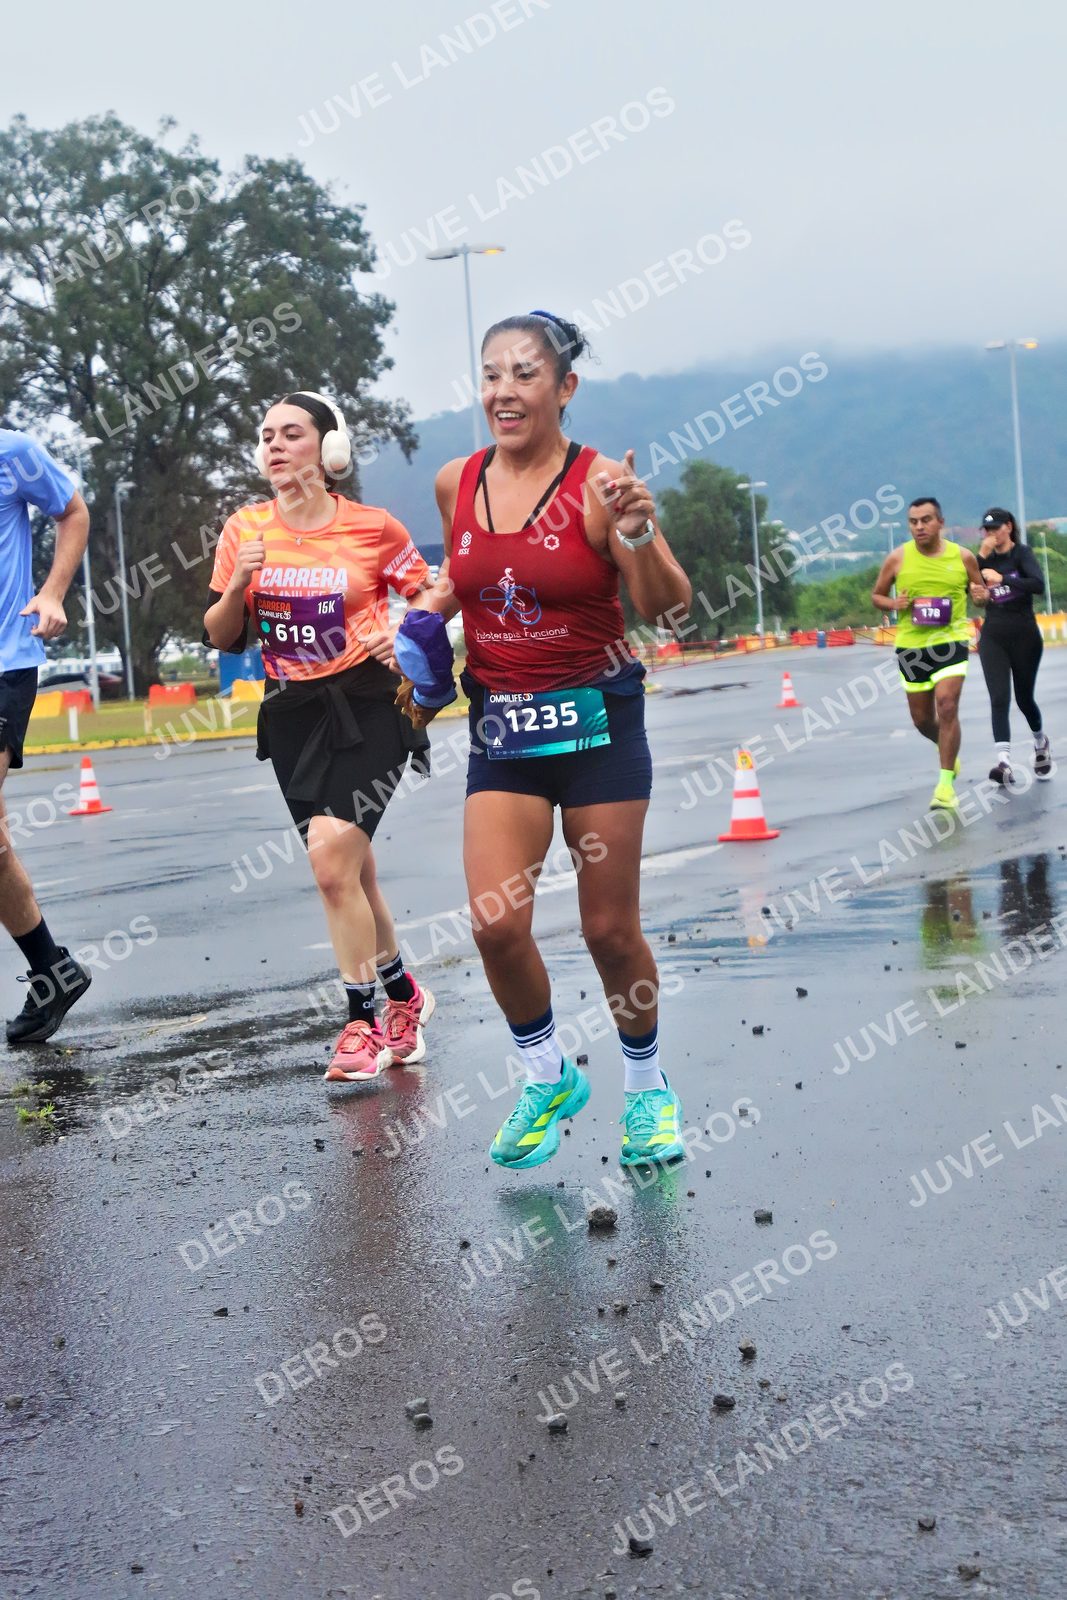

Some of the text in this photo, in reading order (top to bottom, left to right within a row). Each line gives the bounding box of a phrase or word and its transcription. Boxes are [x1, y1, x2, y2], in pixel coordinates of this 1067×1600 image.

[259, 567, 348, 588] CARRERA
[258, 600, 291, 611] CARRERA
[318, 600, 336, 614] 15K
[275, 623, 316, 644] 619
[490, 693, 523, 703] OMNILIFE
[505, 701, 579, 732] 1235
